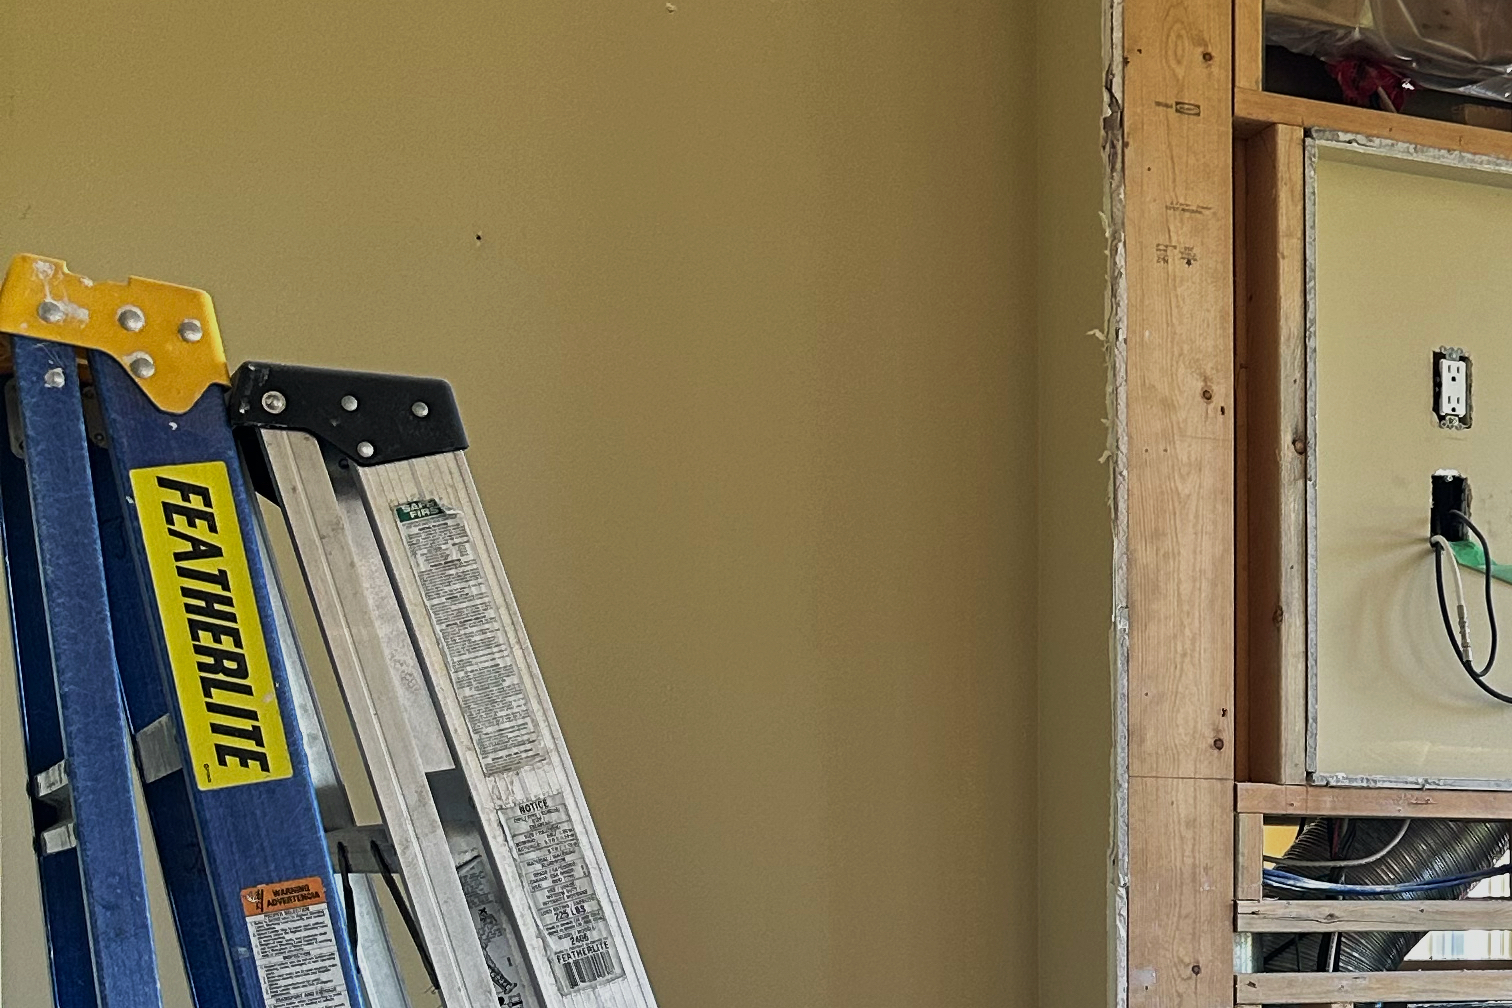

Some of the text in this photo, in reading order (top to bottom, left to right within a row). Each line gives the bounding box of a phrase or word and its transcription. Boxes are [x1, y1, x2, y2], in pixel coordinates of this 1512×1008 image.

[409, 506, 440, 519] FIRS
[155, 475, 271, 774] FEATHERLITE
[519, 797, 550, 815] NOTICE
[272, 885, 310, 898] WARNING
[556, 940, 610, 965] FEATHERLITE
